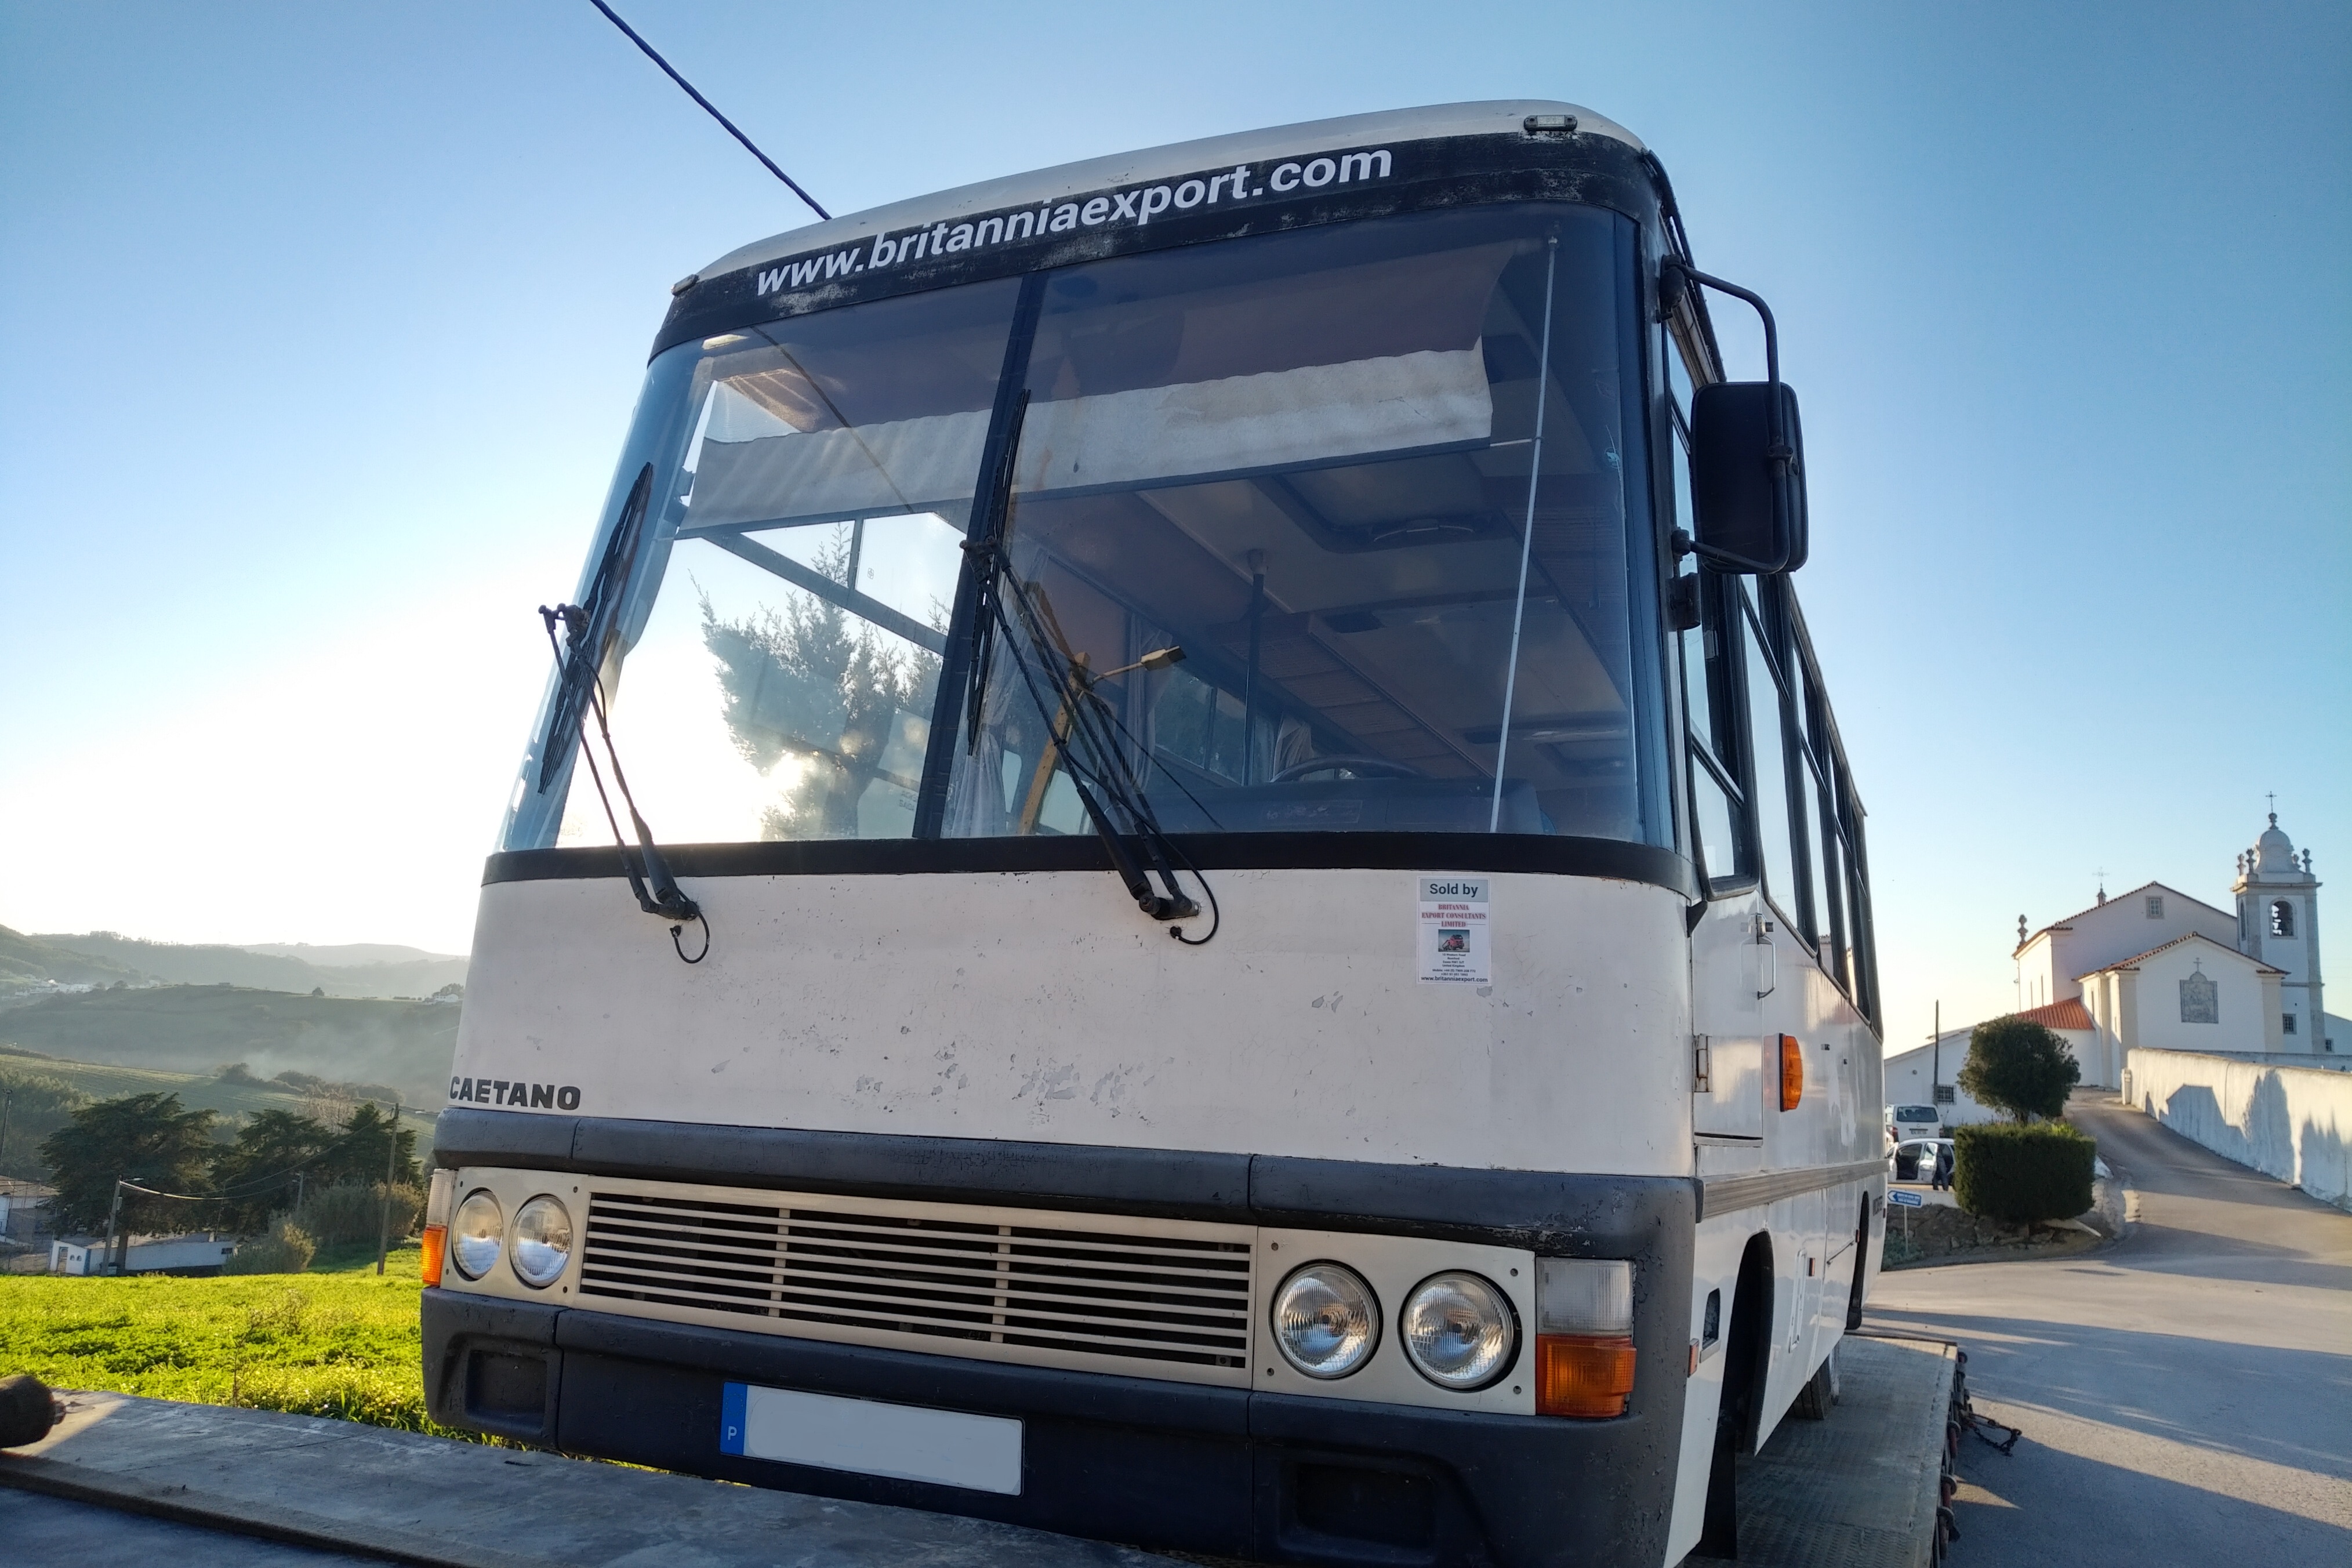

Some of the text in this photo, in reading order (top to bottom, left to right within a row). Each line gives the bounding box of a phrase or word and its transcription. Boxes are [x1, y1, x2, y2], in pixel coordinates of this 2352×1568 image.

[757, 148, 1391, 296] www.britanniaexport.com
[1429, 883, 1478, 898] Sold by
[449, 1076, 580, 1110] CAETANO
[728, 1425, 737, 1440] P
